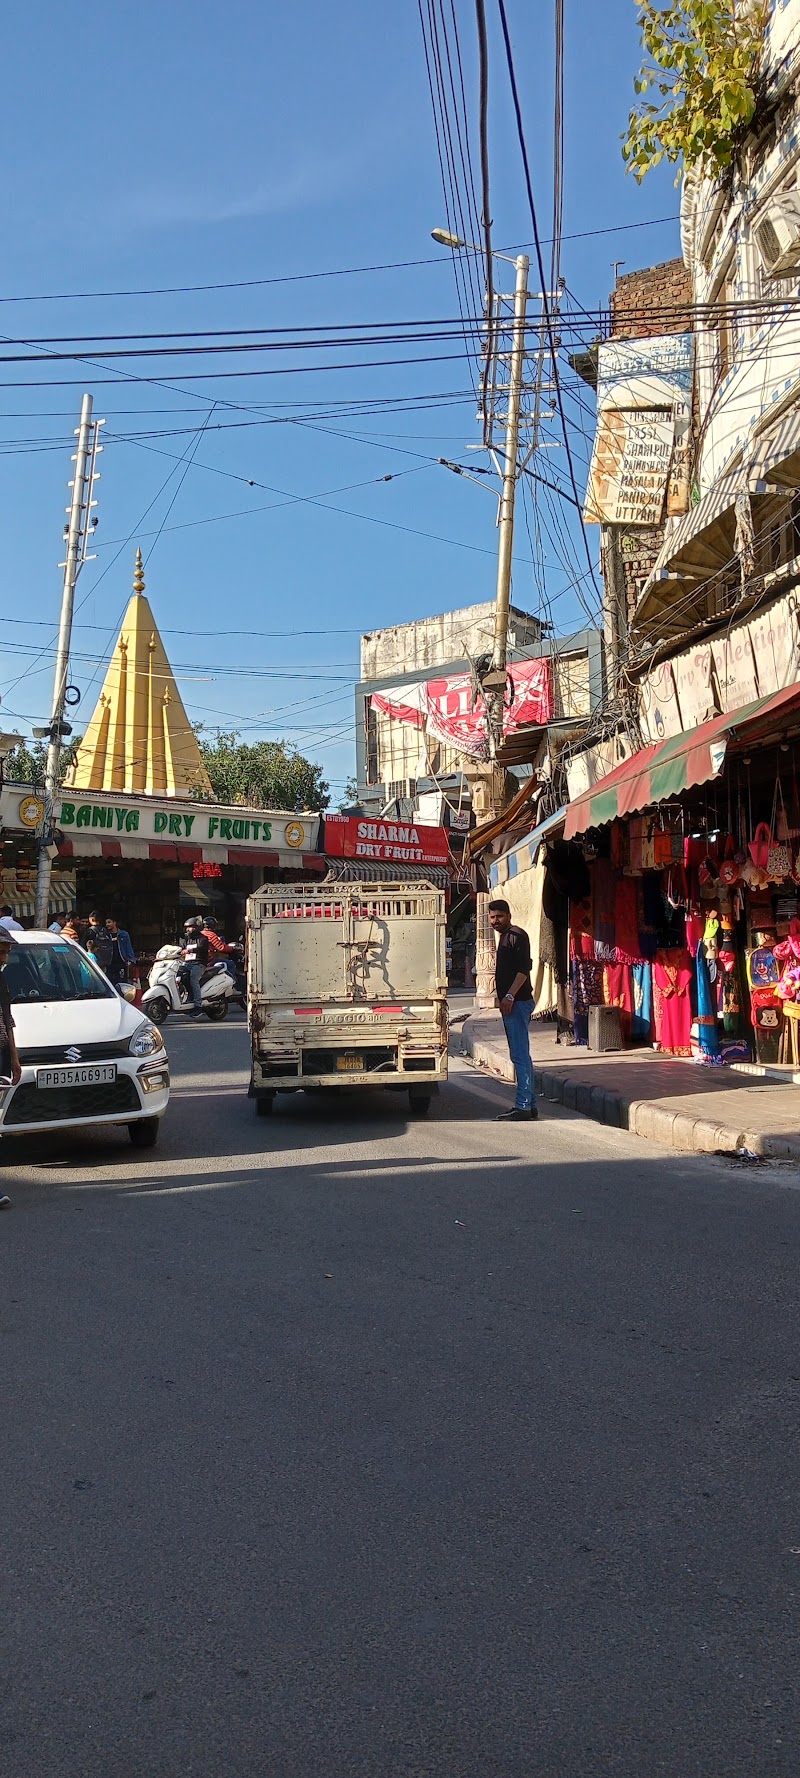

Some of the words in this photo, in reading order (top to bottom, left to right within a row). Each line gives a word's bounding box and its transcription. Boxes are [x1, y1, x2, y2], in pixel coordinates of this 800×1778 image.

[616, 506, 657, 522] UTTPAM
[60, 802, 140, 832] BANIYA
[154, 811, 196, 837] DRY
[208, 816, 272, 841] FRUITS
[357, 823, 419, 844] SHARMA
[355, 842, 383, 857] DRY
[384, 845, 423, 860] FRUIT
[314, 1013, 366, 1024] PIAGGIO
[46, 1068, 115, 1085] PB35AG6913
